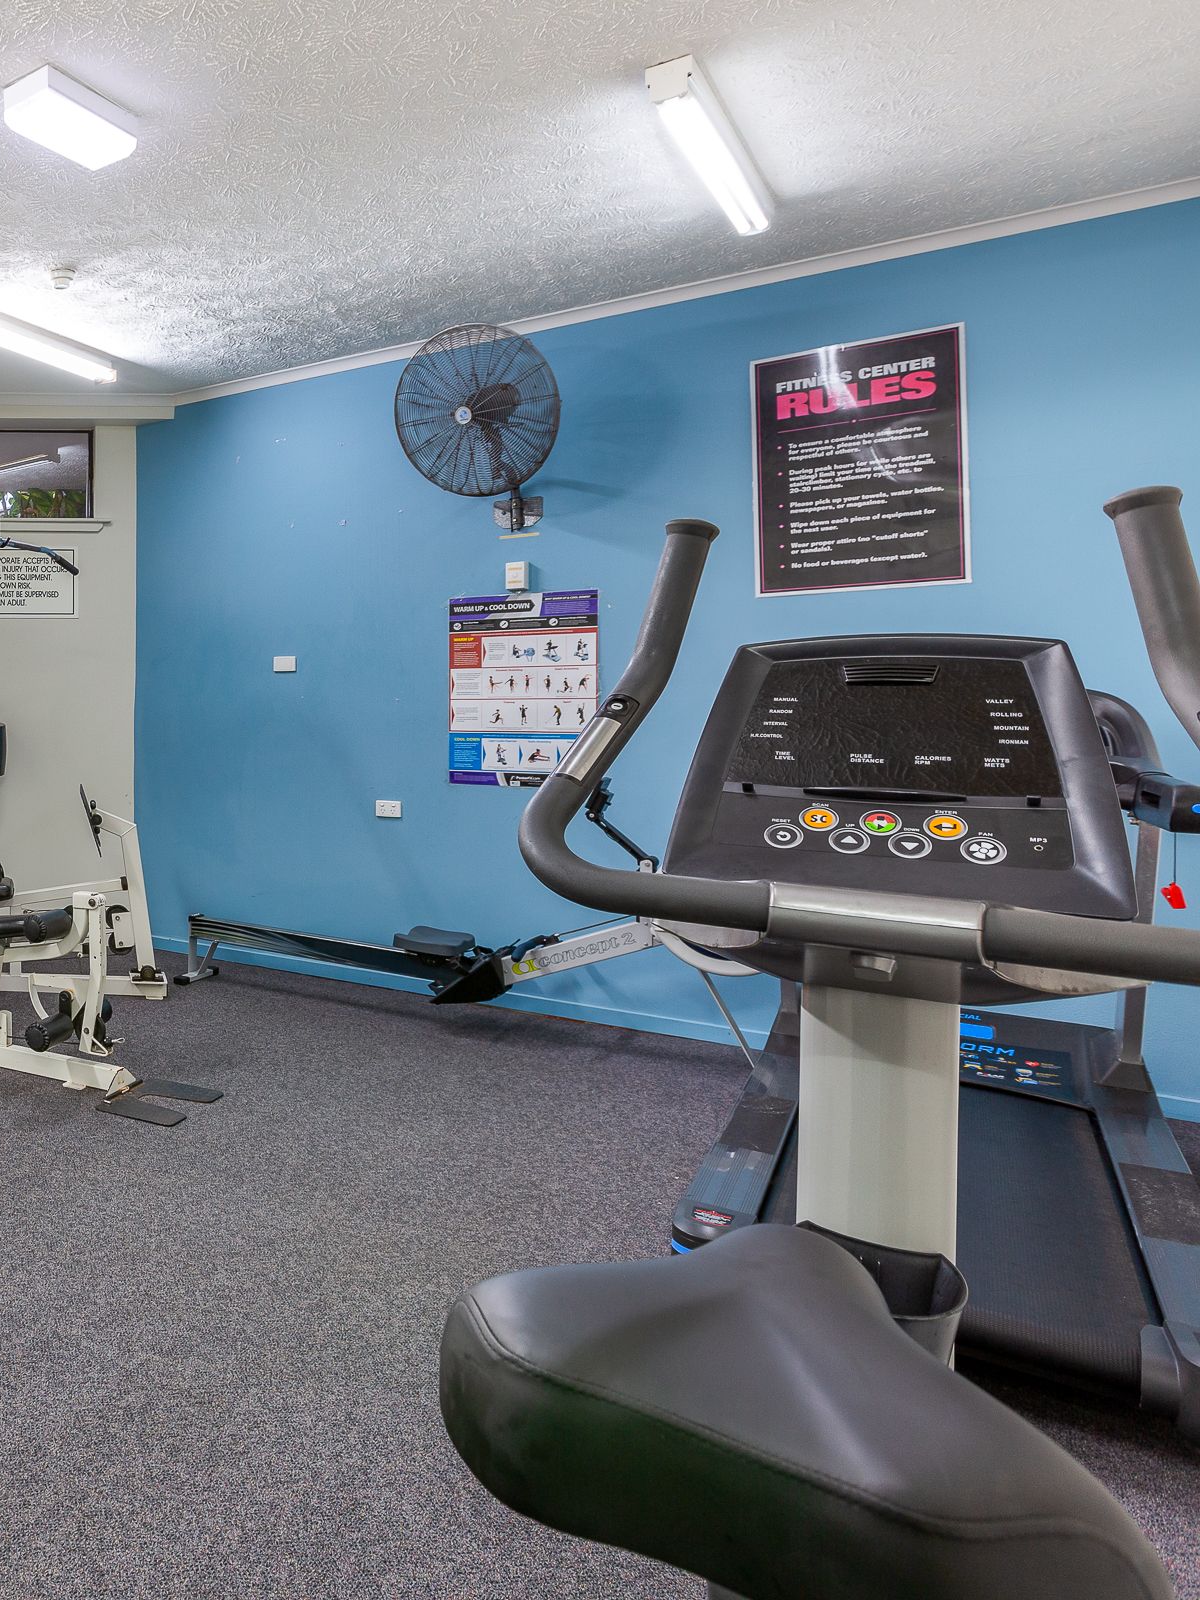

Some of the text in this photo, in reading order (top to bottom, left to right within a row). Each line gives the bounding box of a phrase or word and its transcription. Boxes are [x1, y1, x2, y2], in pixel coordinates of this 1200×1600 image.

[858, 356, 936, 379] CENTER
[776, 370, 936, 420] RULES
[830, 432, 874, 443] comfortable
[836, 442, 860, 450] please
[874, 434, 912, 444] courteous
[815, 498, 831, 506] pick
[881, 510, 922, 519] equipment
[831, 557, 869, 566] beverages
[810, 814, 827, 823] SC
[539, 932, 636, 968] concept 2
